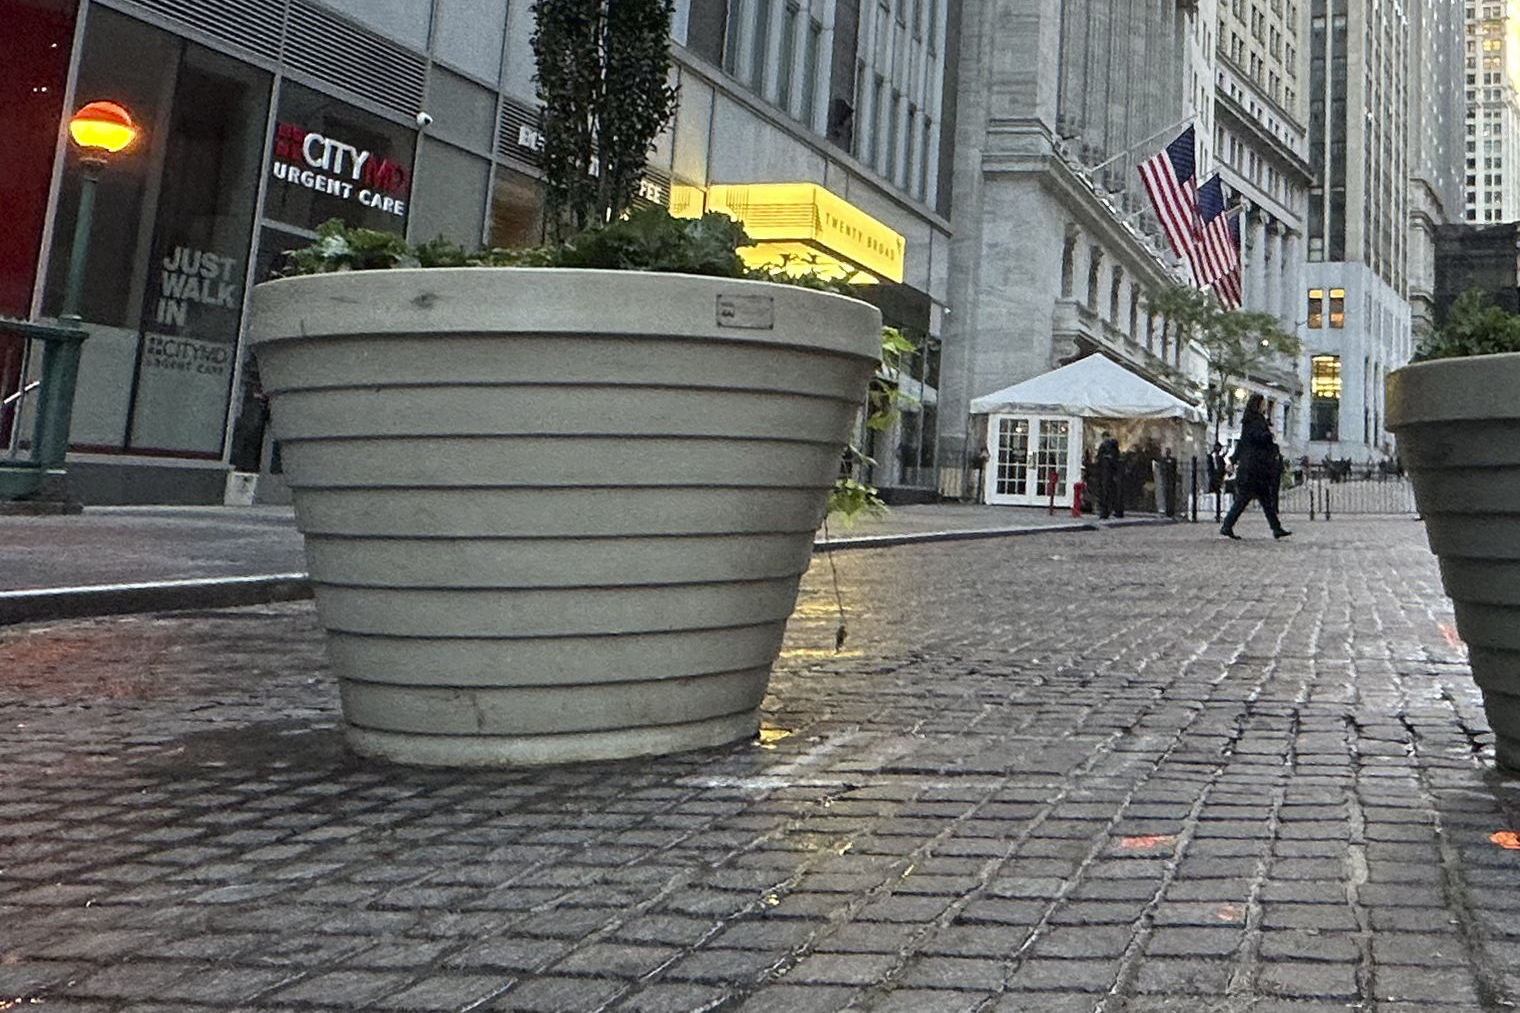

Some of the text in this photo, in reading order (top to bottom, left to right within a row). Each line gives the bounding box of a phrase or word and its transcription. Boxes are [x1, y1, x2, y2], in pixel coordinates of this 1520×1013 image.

[302, 132, 407, 193] CITYMD
[273, 161, 406, 216] URGENT CARE
[825, 212, 895, 261] TWENTY BROAD
[163, 246, 237, 281] JUST
[162, 270, 236, 309] WALK
[157, 297, 188, 327] IN
